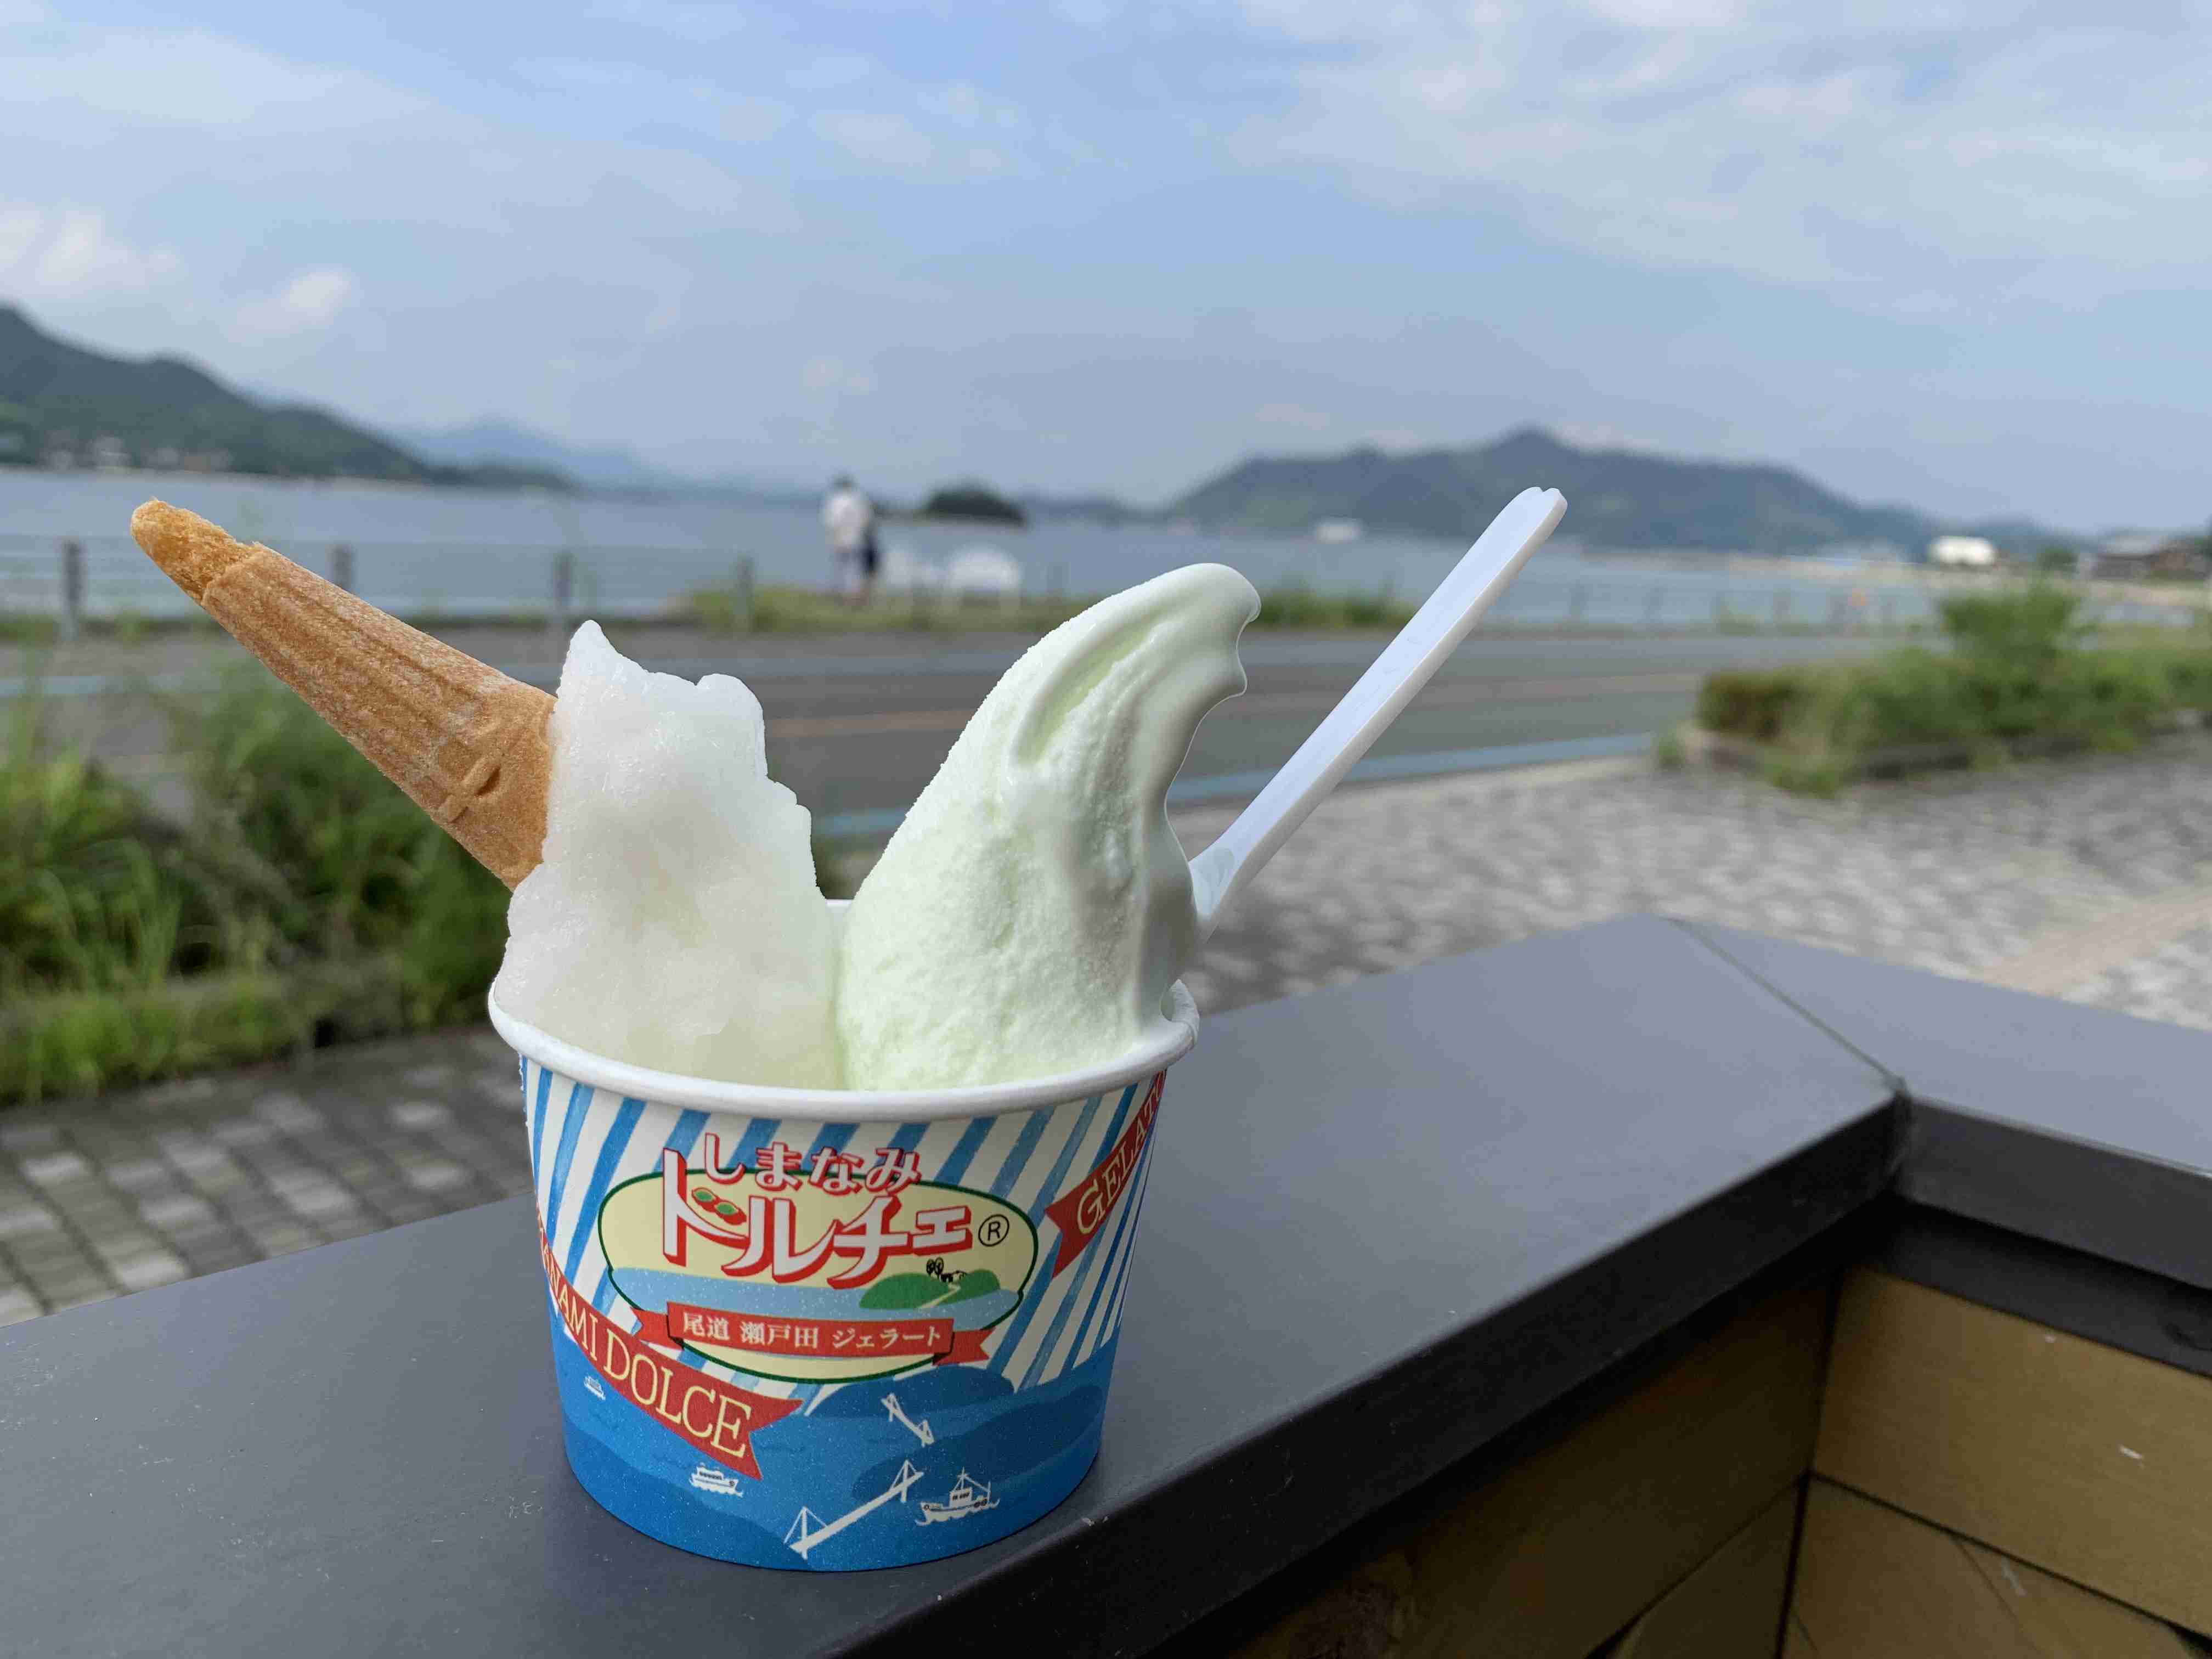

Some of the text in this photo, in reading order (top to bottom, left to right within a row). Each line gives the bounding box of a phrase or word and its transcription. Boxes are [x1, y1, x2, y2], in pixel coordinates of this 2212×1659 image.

[704, 1132, 923, 1194] しまなみ
[682, 1311, 941, 1349] 尾道 瀬戸田 ジェラート
[603, 1329, 752, 1458] DOLCE
